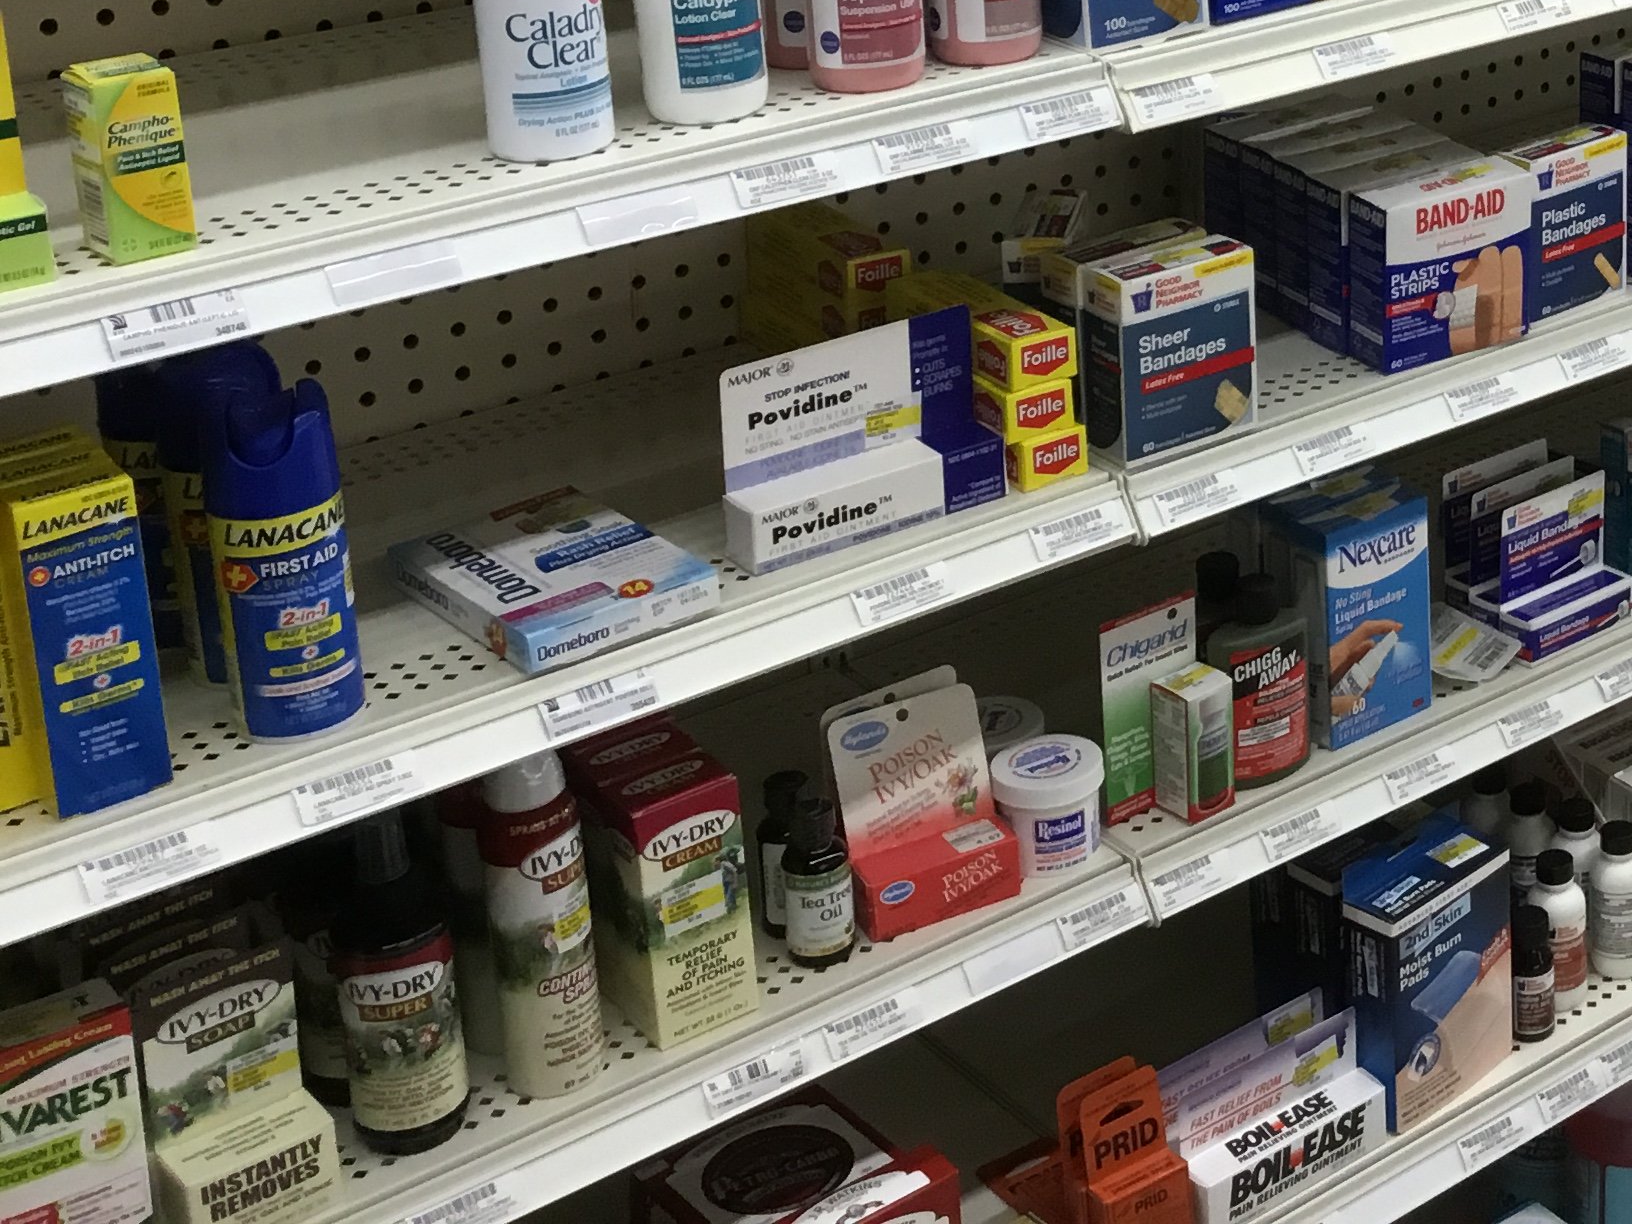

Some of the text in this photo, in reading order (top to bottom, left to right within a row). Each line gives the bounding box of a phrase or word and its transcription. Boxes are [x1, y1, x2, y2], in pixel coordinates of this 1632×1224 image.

[840, 3, 896, 17] Suspension
[1104, 17, 1127, 32] 100
[527, 38, 598, 70] Clear
[107, 127, 177, 148] Phenique
[108, 115, 175, 136] Campho-
[1416, 189, 1504, 234] BAND-AID
[1542, 202, 1585, 226] Plastic
[1542, 213, 1605, 245] Bandages
[1391, 262, 1449, 286] PLASTIC
[1391, 277, 1439, 298] STRIPS
[1022, 344, 1069, 369] Foille
[1138, 326, 1191, 355] Sheer
[1139, 336, 1227, 377] Bandages
[727, 365, 771, 387] MAJOR
[765, 371, 850, 402] STOP INFECTION!
[1035, 442, 1079, 468] Foille
[22, 496, 129, 540] LANACANE
[52, 543, 135, 579] ANTI-ITCH
[260, 544, 338, 578] FIRST AID
[1338, 523, 1417, 573] Nexcare
[1335, 587, 1407, 625] Liquid Bandage
[70, 629, 120, 657] 2-in-1
[537, 625, 610, 663] Domeboro
[1107, 621, 1187, 668] Chigarid
[1234, 648, 1281, 683] CHIGG
[869, 730, 943, 777] POISON
[872, 746, 957, 803] IVY/OAK
[651, 814, 732, 858] IVY-DRY
[1036, 815, 1082, 840] Resinol
[665, 837, 721, 869] CREAM
[820, 904, 843, 922] Oil
[1404, 907, 1464, 952] 2nd Skin
[667, 930, 738, 966] TEMPORARY
[1401, 934, 1462, 976] Moist Burn
[347, 968, 436, 1000] IVY-DRY
[1401, 967, 1430, 991] Pads
[166, 987, 270, 1040] IVY-DRY
[363, 999, 427, 1019] SUPER
[189, 1016, 250, 1046] SOAP
[1191, 1074, 1282, 1131] FAST RELIEF FROM
[1097, 1119, 1160, 1171] PRID
[200, 1135, 323, 1204] INSTANTLY
[1229, 1138, 1362, 1221] PAIN RELIEVING OINTMENT
[211, 1160, 321, 1222] REMOVES
